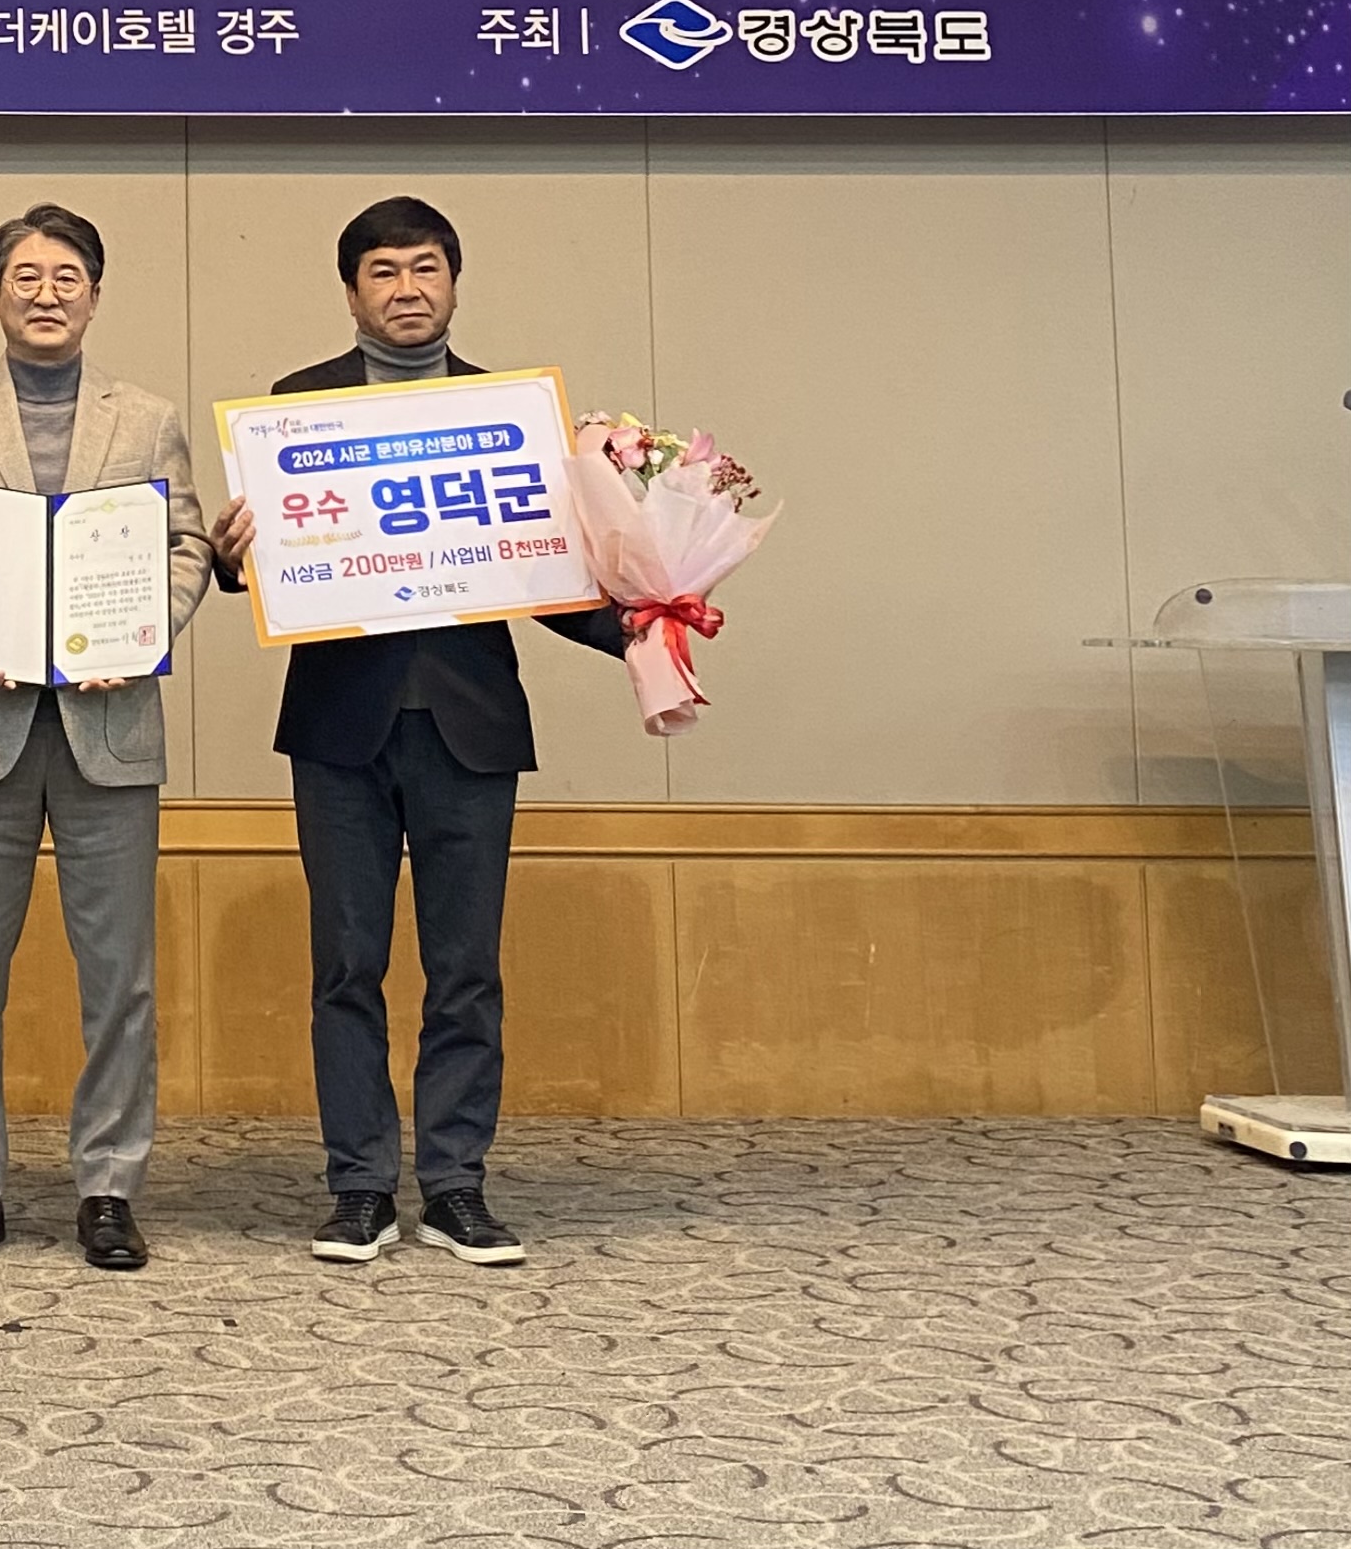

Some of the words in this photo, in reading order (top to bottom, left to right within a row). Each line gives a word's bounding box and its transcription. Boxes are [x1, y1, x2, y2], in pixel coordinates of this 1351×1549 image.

[216, 8, 300, 55] 경주
[476, 7, 560, 55] 주최
[738, 9, 991, 64] 경상북도
[292, 448, 335, 468] 2024
[340, 444, 372, 463] 시군
[375, 433, 474, 460] 문화유산분야
[478, 429, 511, 449] 평가
[282, 490, 349, 529] 우수
[371, 463, 552, 536] 영덕군
[280, 562, 333, 585] 시상금
[339, 552, 424, 578] 200만원
[440, 545, 493, 566] 사업비
[497, 536, 569, 560] 8천만원
